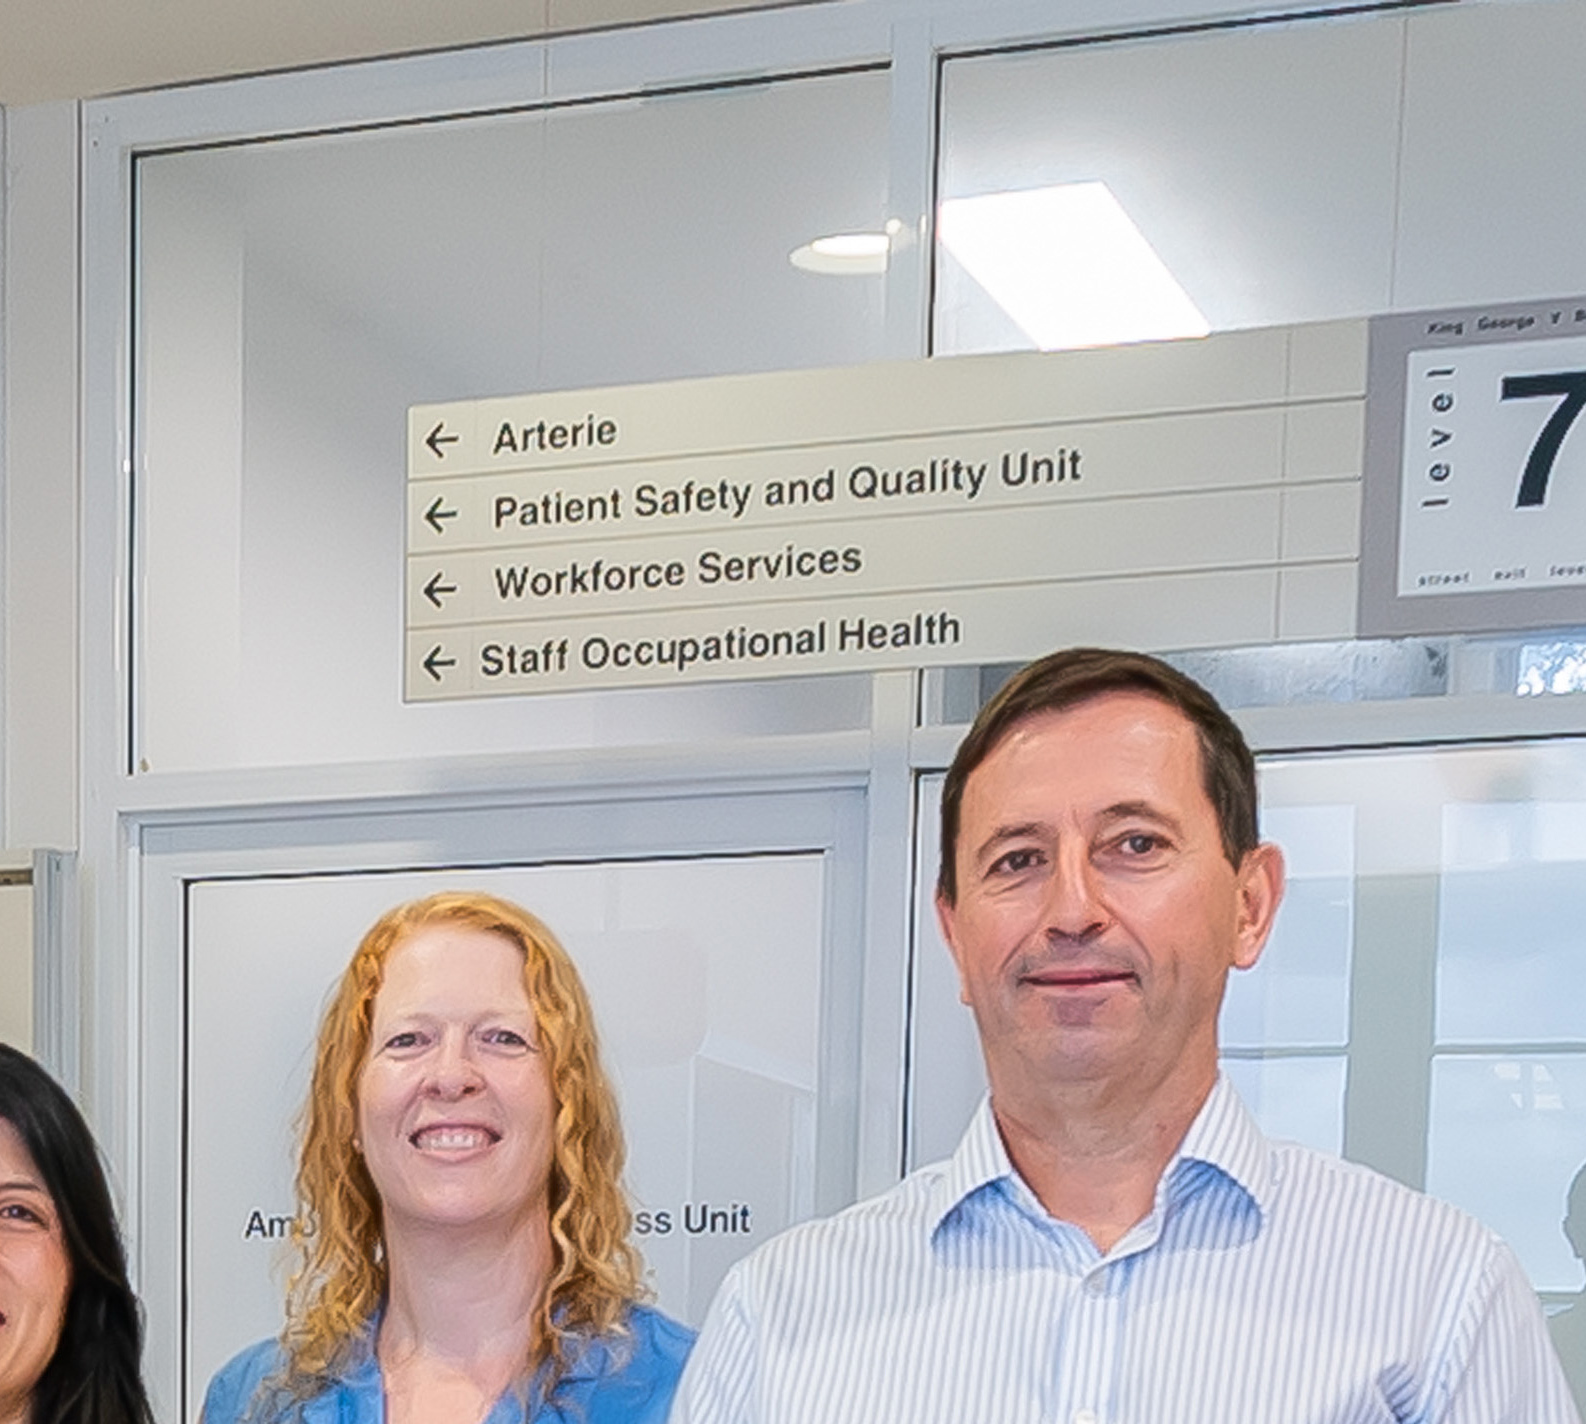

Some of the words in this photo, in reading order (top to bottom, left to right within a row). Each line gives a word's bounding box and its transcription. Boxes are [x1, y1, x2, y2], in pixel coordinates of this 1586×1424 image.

[492, 413, 618, 455] Arterie
[494, 488, 623, 530] Patient
[633, 478, 753, 519] Safety
[764, 468, 836, 507] and
[847, 457, 989, 500] Quality
[1000, 448, 1083, 488] Unit
[494, 558, 687, 600] Workforce
[697, 544, 864, 585] Services
[480, 637, 569, 677] Staff
[581, 620, 828, 673] Occupational
[839, 611, 961, 651] Health
[684, 1203, 750, 1233] Unit
